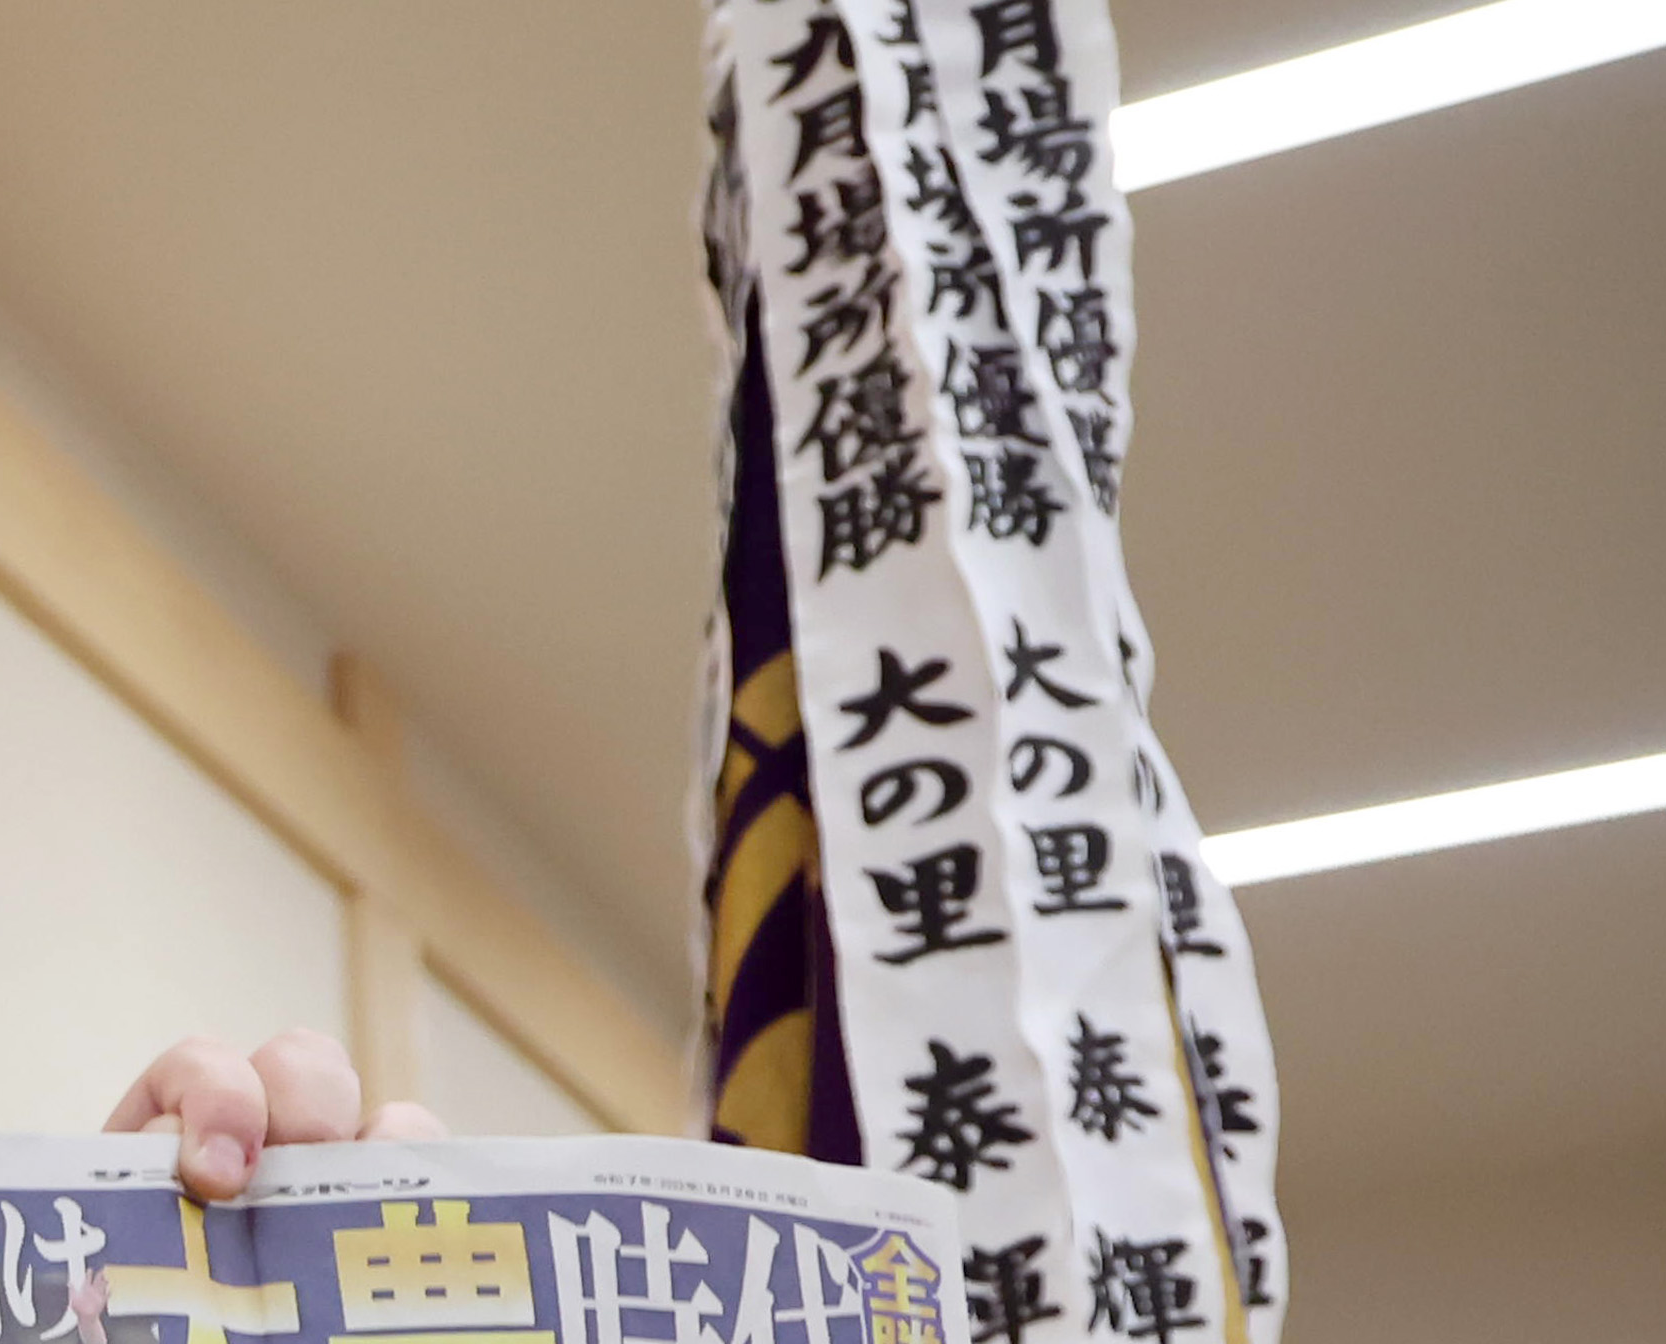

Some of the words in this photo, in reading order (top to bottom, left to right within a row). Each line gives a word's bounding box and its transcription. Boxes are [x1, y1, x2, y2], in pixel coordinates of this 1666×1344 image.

[835, 646, 1007, 967] 大の里
[1004, 615, 1129, 918] 大の里
